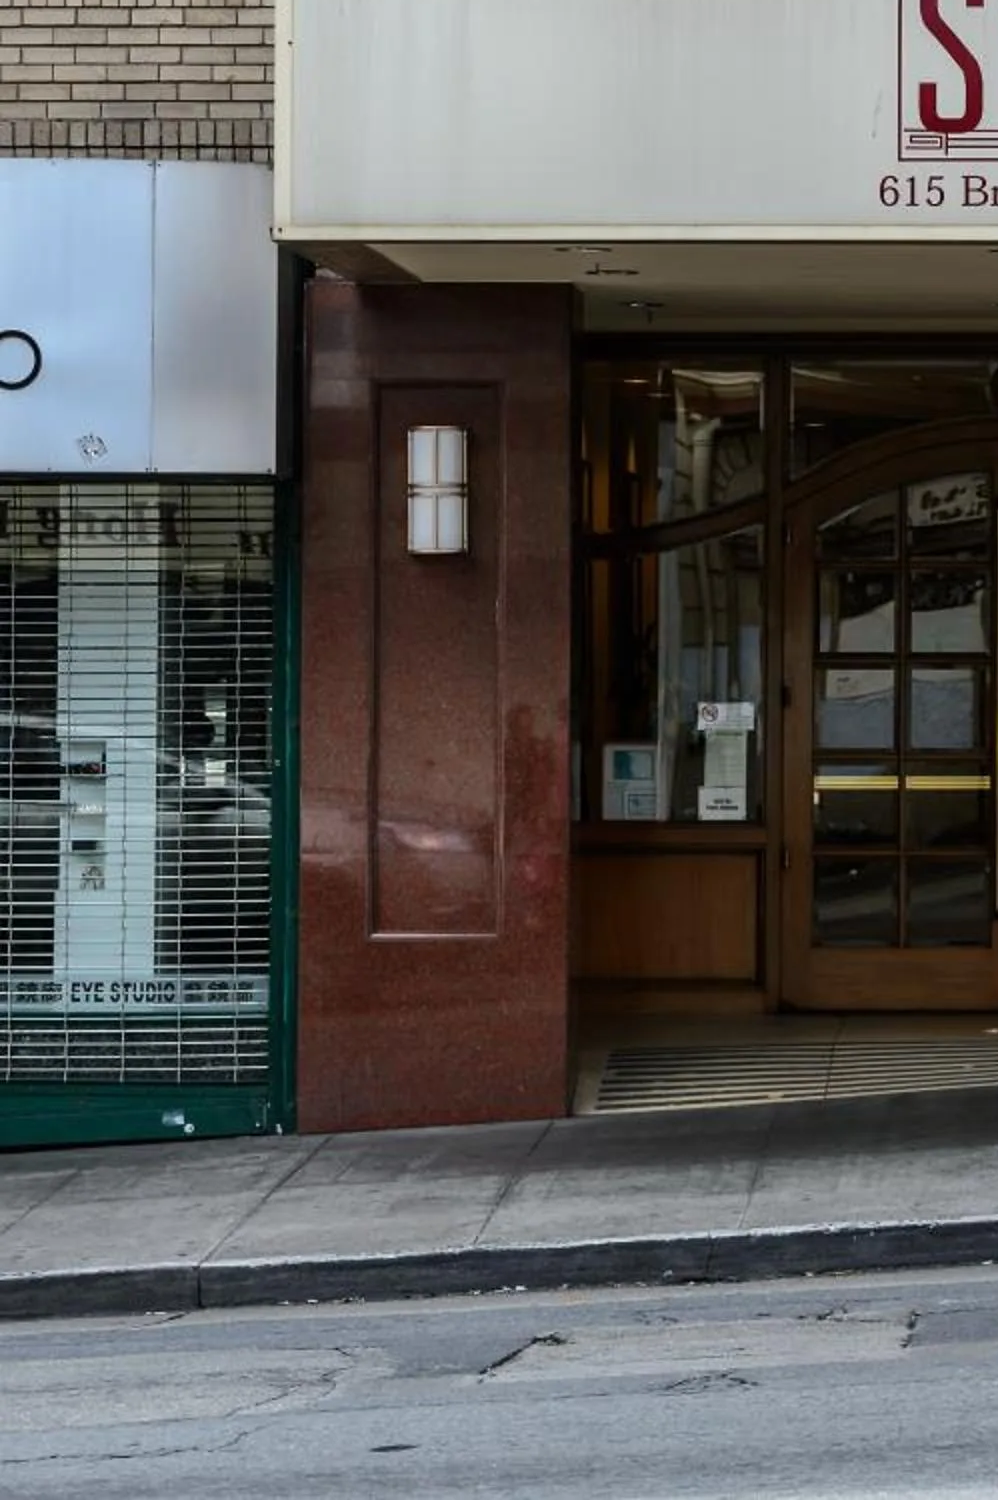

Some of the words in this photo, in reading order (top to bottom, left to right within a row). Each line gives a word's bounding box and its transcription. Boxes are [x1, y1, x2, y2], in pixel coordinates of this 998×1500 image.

[879, 175, 946, 208] 615
[71, 981, 105, 1003] EYE
[109, 981, 176, 1003] STUDIO
